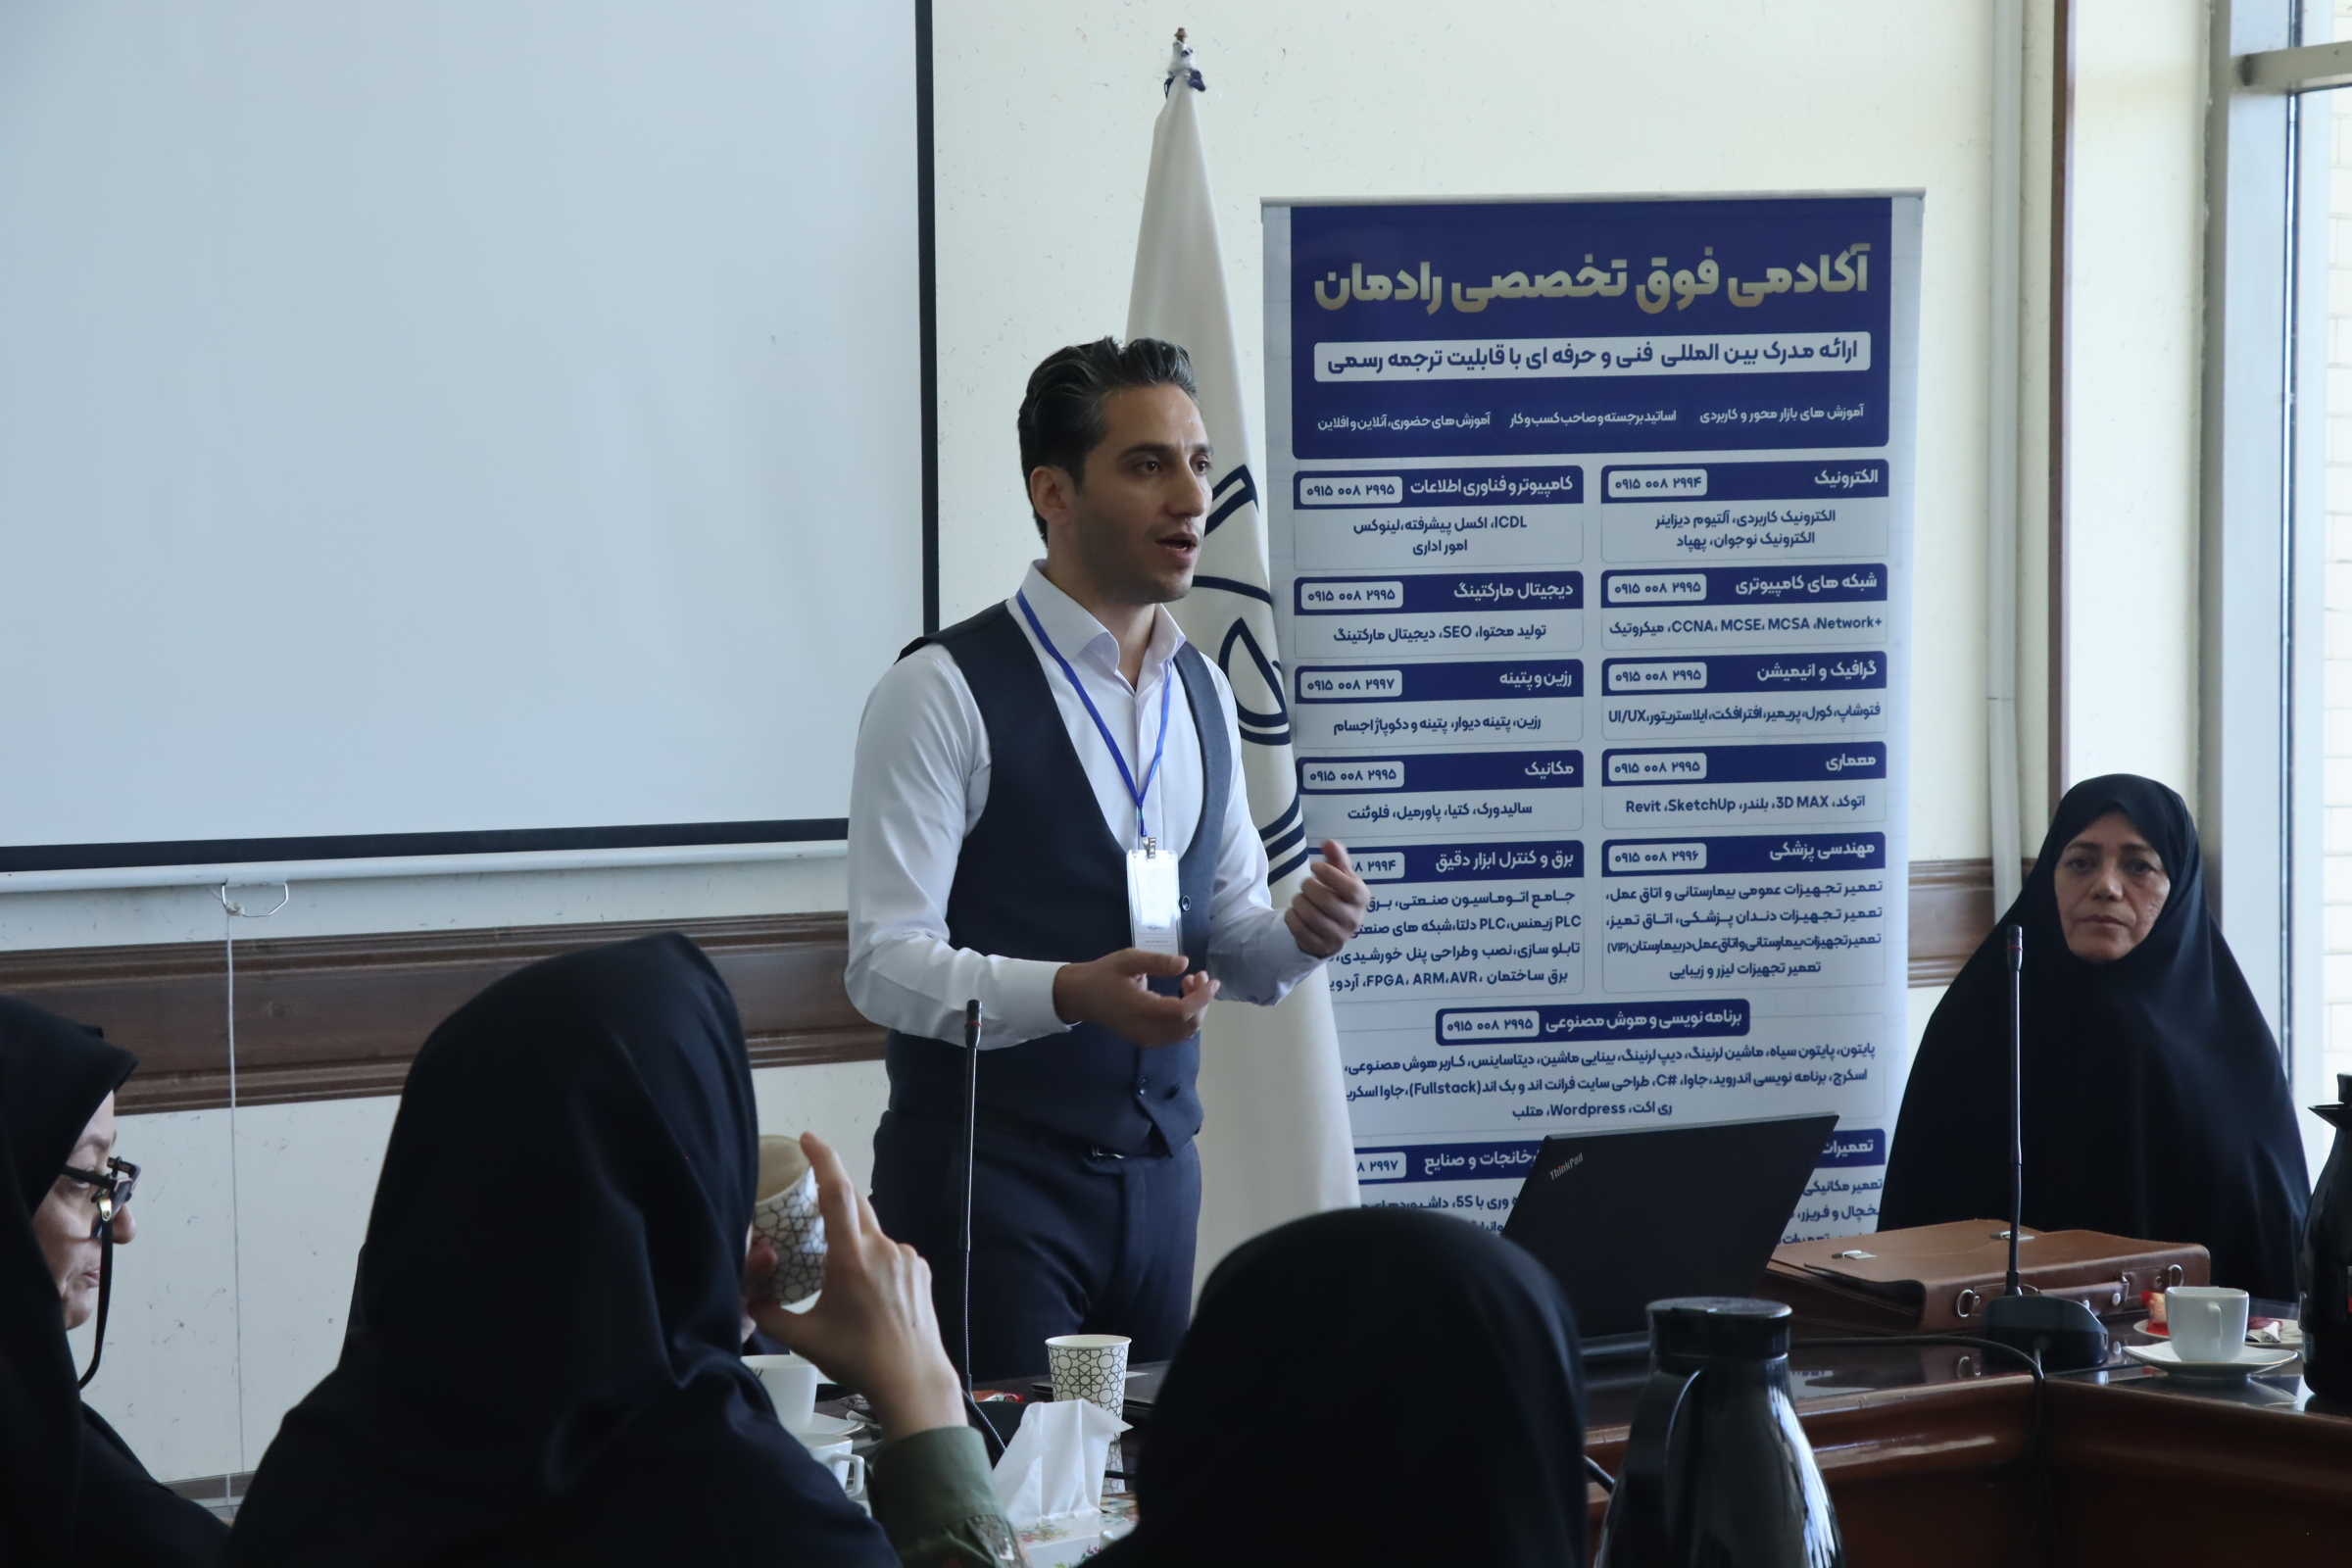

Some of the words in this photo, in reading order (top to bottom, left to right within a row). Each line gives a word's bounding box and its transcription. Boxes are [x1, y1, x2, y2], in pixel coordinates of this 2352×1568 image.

[1451, 254, 1627, 312] تخصصی
[1637, 248, 1719, 314] فوق
[1728, 244, 1870, 307] آکادمی
[1315, 262, 1442, 315] رادمان
[1447, 344, 1504, 370] قابلیت
[1509, 347, 1521, 369] با
[1526, 347, 1547, 369] ای
[1552, 343, 1596, 369] حرفه
[1616, 341, 1652, 368] فنی
[1661, 343, 1719, 368] المللی
[1724, 345, 1759, 366] بین
[1763, 341, 1814, 366] مدرک
[1819, 337, 1857, 364] ارائه
[1328, 357, 1383, 374] رسمی
[1388, 350, 1443, 372] ترجمه
[1601, 352, 1611, 368] و
[1700, 408, 1738, 423] کاربردی
[1740, 412, 1747, 423] و
[1748, 411, 1778, 422] محور
[1779, 408, 1797, 422] بازار
[1800, 407, 1825, 421] های
[1827, 404, 1864, 420] آموزش
[1410, 478, 1461, 493] اطلاعات
[1463, 475, 1506, 497] فناوری
[1517, 475, 1573, 498] کامپیوتر
[1615, 478, 1641, 489] ۰۹۱۵
[1645, 478, 1668, 488] ۰۰۸
[1673, 476, 1701, 488] ۲۹۹۴
[1815, 468, 1878, 488] الکترونیک
[1306, 485, 1333, 496] ۰۹۱۵
[1338, 485, 1361, 495] ۰۰۸
[1366, 484, 1395, 495] ۲۹۹۵
[1508, 482, 1516, 496] و
[1655, 514, 1690, 529] دیزاینر
[1693, 510, 1730, 528] آلتیوم
[1733, 511, 1778, 527] کاربردی،
[1781, 510, 1836, 526] الکترونیک
[1413, 540, 1442, 556] اداری
[1444, 539, 1467, 555] امور
[1677, 535, 1706, 552] پهپاد
[1710, 534, 1757, 549] نوجوان،
[1760, 531, 1815, 548] الکترونیک
[1615, 583, 1641, 594] ۰۹۱۵
[1644, 583, 1667, 593] ۰۰۸
[1672, 581, 1701, 593] ۲۹۹۵
[1736, 575, 1804, 597] کامپیوتری
[1808, 575, 1838, 593] های
[1842, 572, 1877, 591] شبکه
[1307, 590, 1334, 602] ۰۹۱۵
[1339, 590, 1361, 601] ۰۰۸
[1366, 589, 1396, 601] ۲۹۹۵
[1454, 582, 1514, 602] مارکتینگ
[1517, 582, 1573, 600] دیجیتال
[1334, 628, 1385, 645] مارکتینگ
[1388, 628, 1436, 643] دیجیتال
[1475, 625, 1514, 641] محتوا،
[1517, 624, 1546, 640] تولید
[1615, 671, 1641, 682] ۰۹۱۵
[1645, 670, 1668, 681] ۰۰۸
[1673, 669, 1701, 680] ۲۹۹۵
[1757, 662, 1815, 681] انیمیشن
[1819, 667, 1827, 681] و
[1831, 660, 1877, 680] گرافیک
[1307, 679, 1333, 691] ۰۹۱۵
[1338, 679, 1361, 690] ۰۰۸
[1365, 678, 1395, 690] ۲۹۹۷
[1499, 672, 1533, 691] پتینه
[1534, 674, 1542, 688] و
[1544, 671, 1572, 687] رزین
[1525, 760, 1574, 779] مکانیک
[1614, 762, 1640, 773] ۰۹۱۵
[1644, 762, 1667, 772] ۰۰۸
[1672, 761, 1700, 772] ۲۹۹۵
[1826, 754, 1877, 771] معماری
[1309, 770, 1336, 781] ۰۹۱۵
[1341, 770, 1363, 781] ۰۰۸
[1368, 768, 1396, 780] ۲۹۹۵
[1499, 850, 1537, 869] کنترل
[1615, 852, 1641, 863] ۰۹۱۵
[1644, 852, 1667, 861] ۰۰۸
[1672, 851, 1698, 861] ۲۹۹۶
[1770, 841, 1814, 862] پزشکی
[1818, 843, 1875, 859] مهندسی
[1436, 851, 1470, 872] دقیق
[1473, 852, 1495, 870] ابزار
[1540, 855, 1548, 868] و
[1551, 851, 1573, 869] برق
[1447, 1020, 1472, 1032] ۰۹۱۵
[1477, 1020, 1499, 1030] ۰۰۸
[1504, 1018, 1533, 1030] ۲۹۹۵
[1545, 1015, 1604, 1033] مصنوعی
[1606, 1011, 1647, 1030] هوش
[1649, 1016, 1657, 1029] و
[1659, 1011, 1703, 1029] نویسی
[1704, 1009, 1741, 1027] برنامه
[1549, 1152, 1584, 1180] ThinkPad
